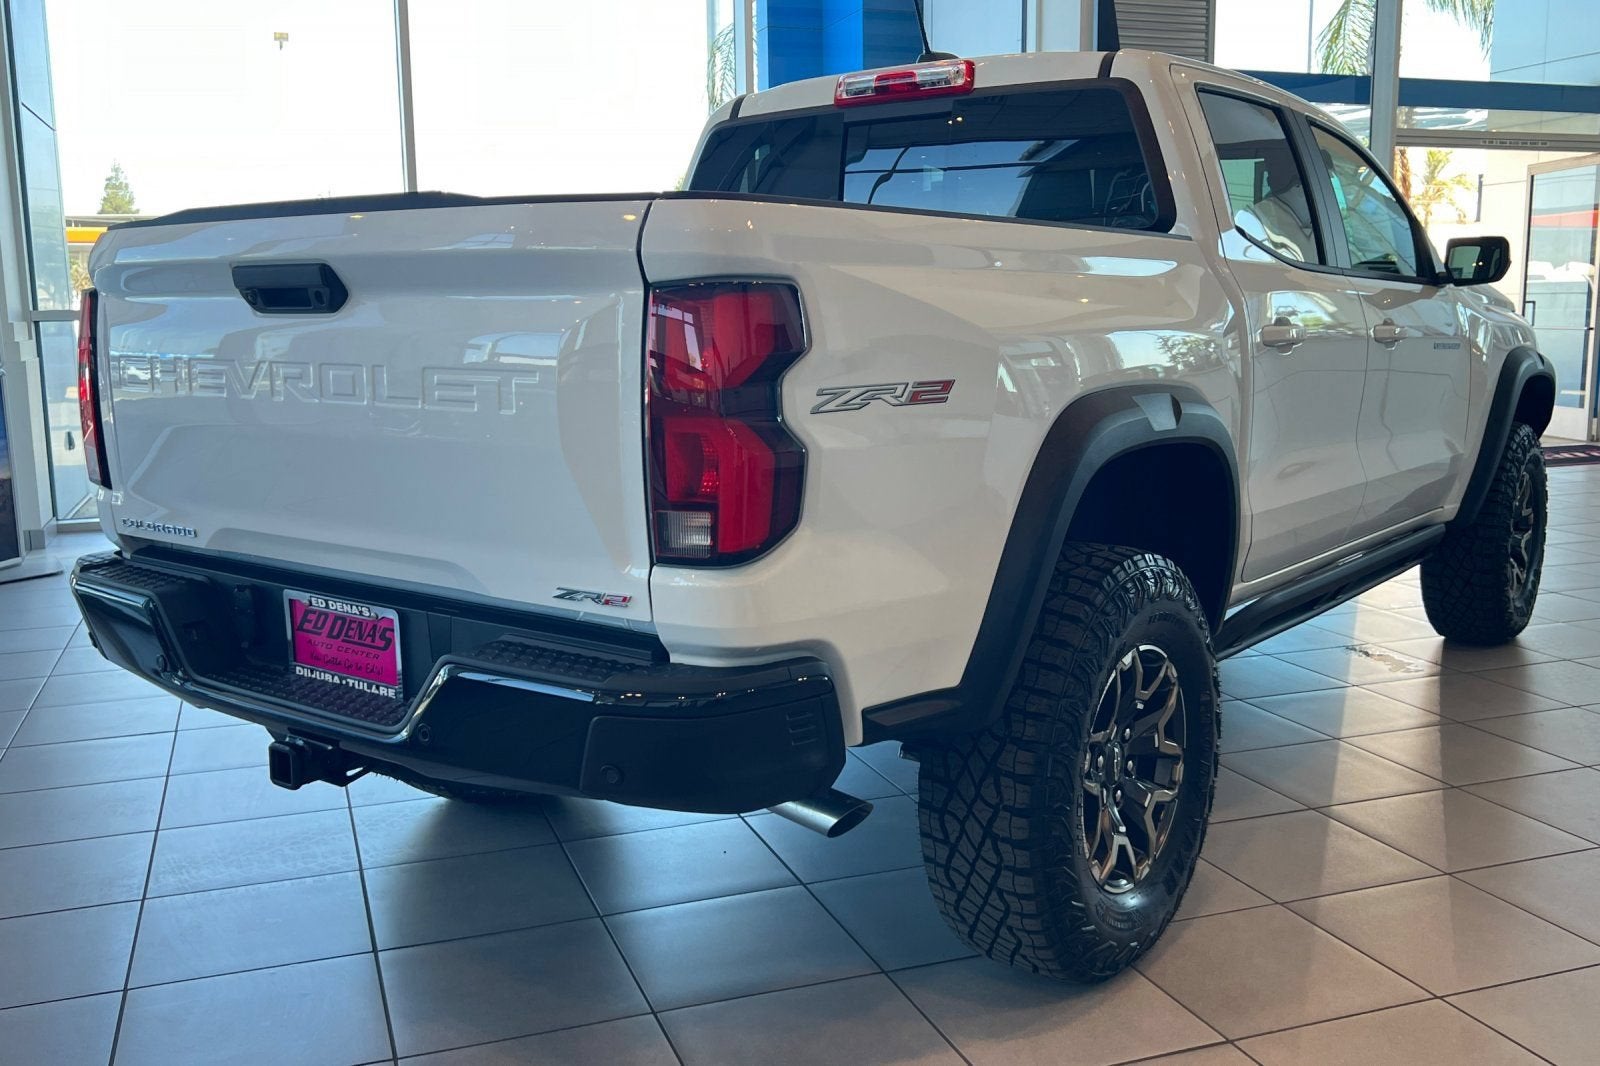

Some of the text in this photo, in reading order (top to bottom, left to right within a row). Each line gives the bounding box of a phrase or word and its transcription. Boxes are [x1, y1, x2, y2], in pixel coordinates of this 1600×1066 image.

[118, 355, 540, 415] CHEVROLET
[810, 379, 956, 414] ZR2
[310, 597, 371, 617] ED DENA'S
[552, 587, 632, 607] ZR2
[296, 609, 395, 652] ED DENA'S
[307, 638, 381, 660] AUTO CENTER
[323, 654, 343, 667] Gotta
[344, 659, 355, 671] Go
[346, 678, 397, 699] TULARE
